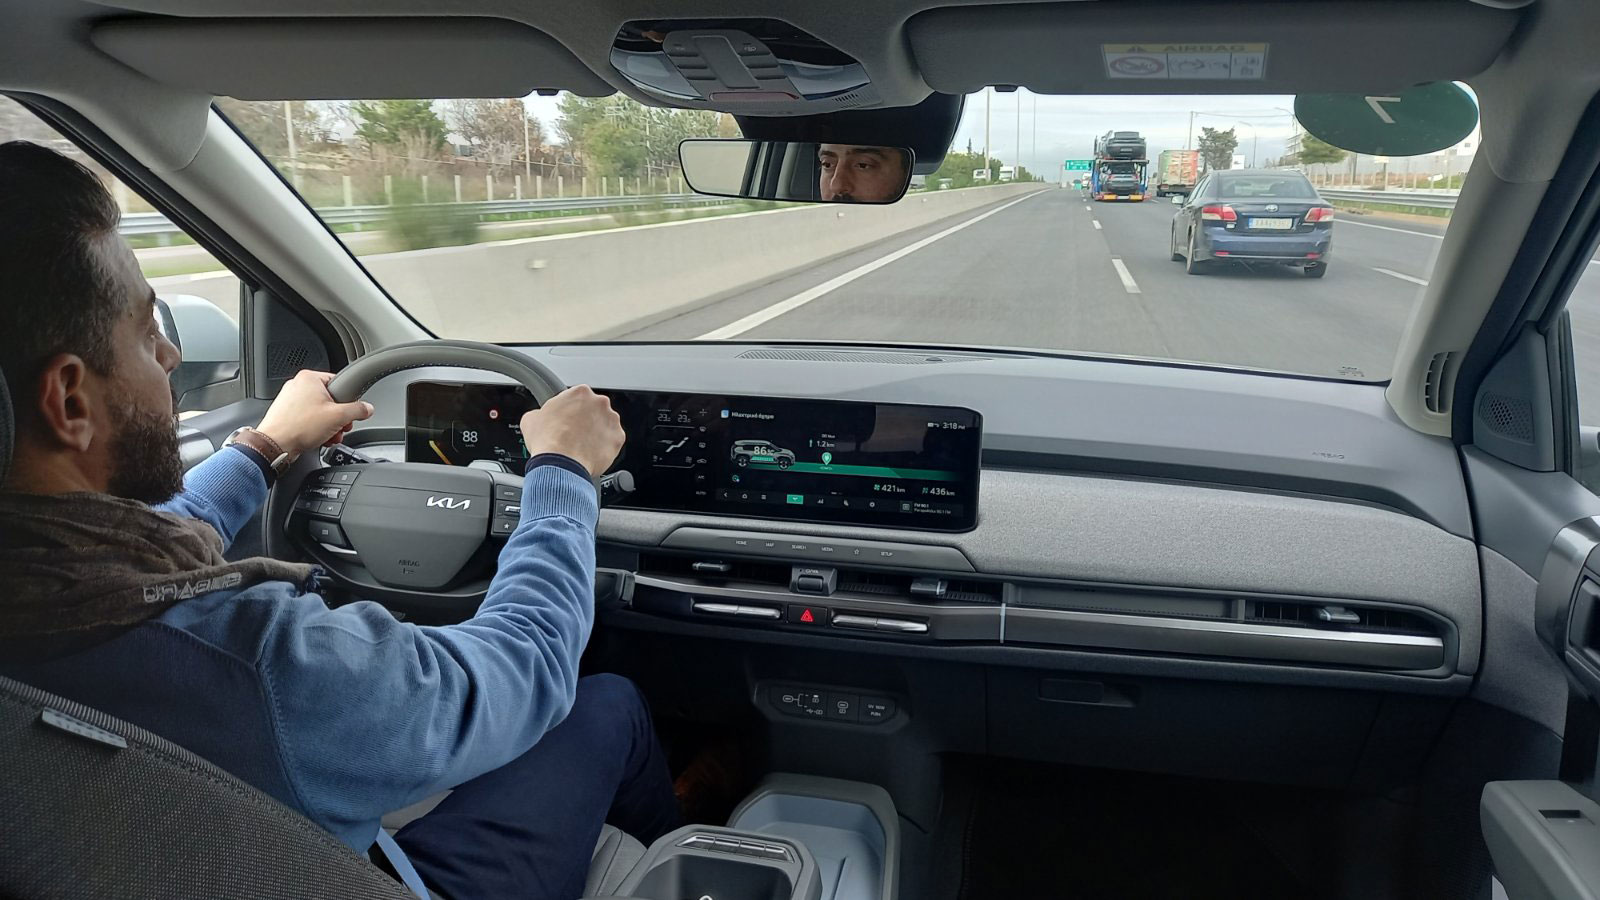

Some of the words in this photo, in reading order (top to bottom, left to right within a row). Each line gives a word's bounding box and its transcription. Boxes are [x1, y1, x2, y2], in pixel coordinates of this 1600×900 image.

[942, 421, 957, 430] 3:18
[462, 430, 478, 443] 88
[816, 440, 826, 448] 1.2
[881, 484, 896, 492] 421
[929, 487, 946, 496] 436
[426, 495, 471, 511] KIA
